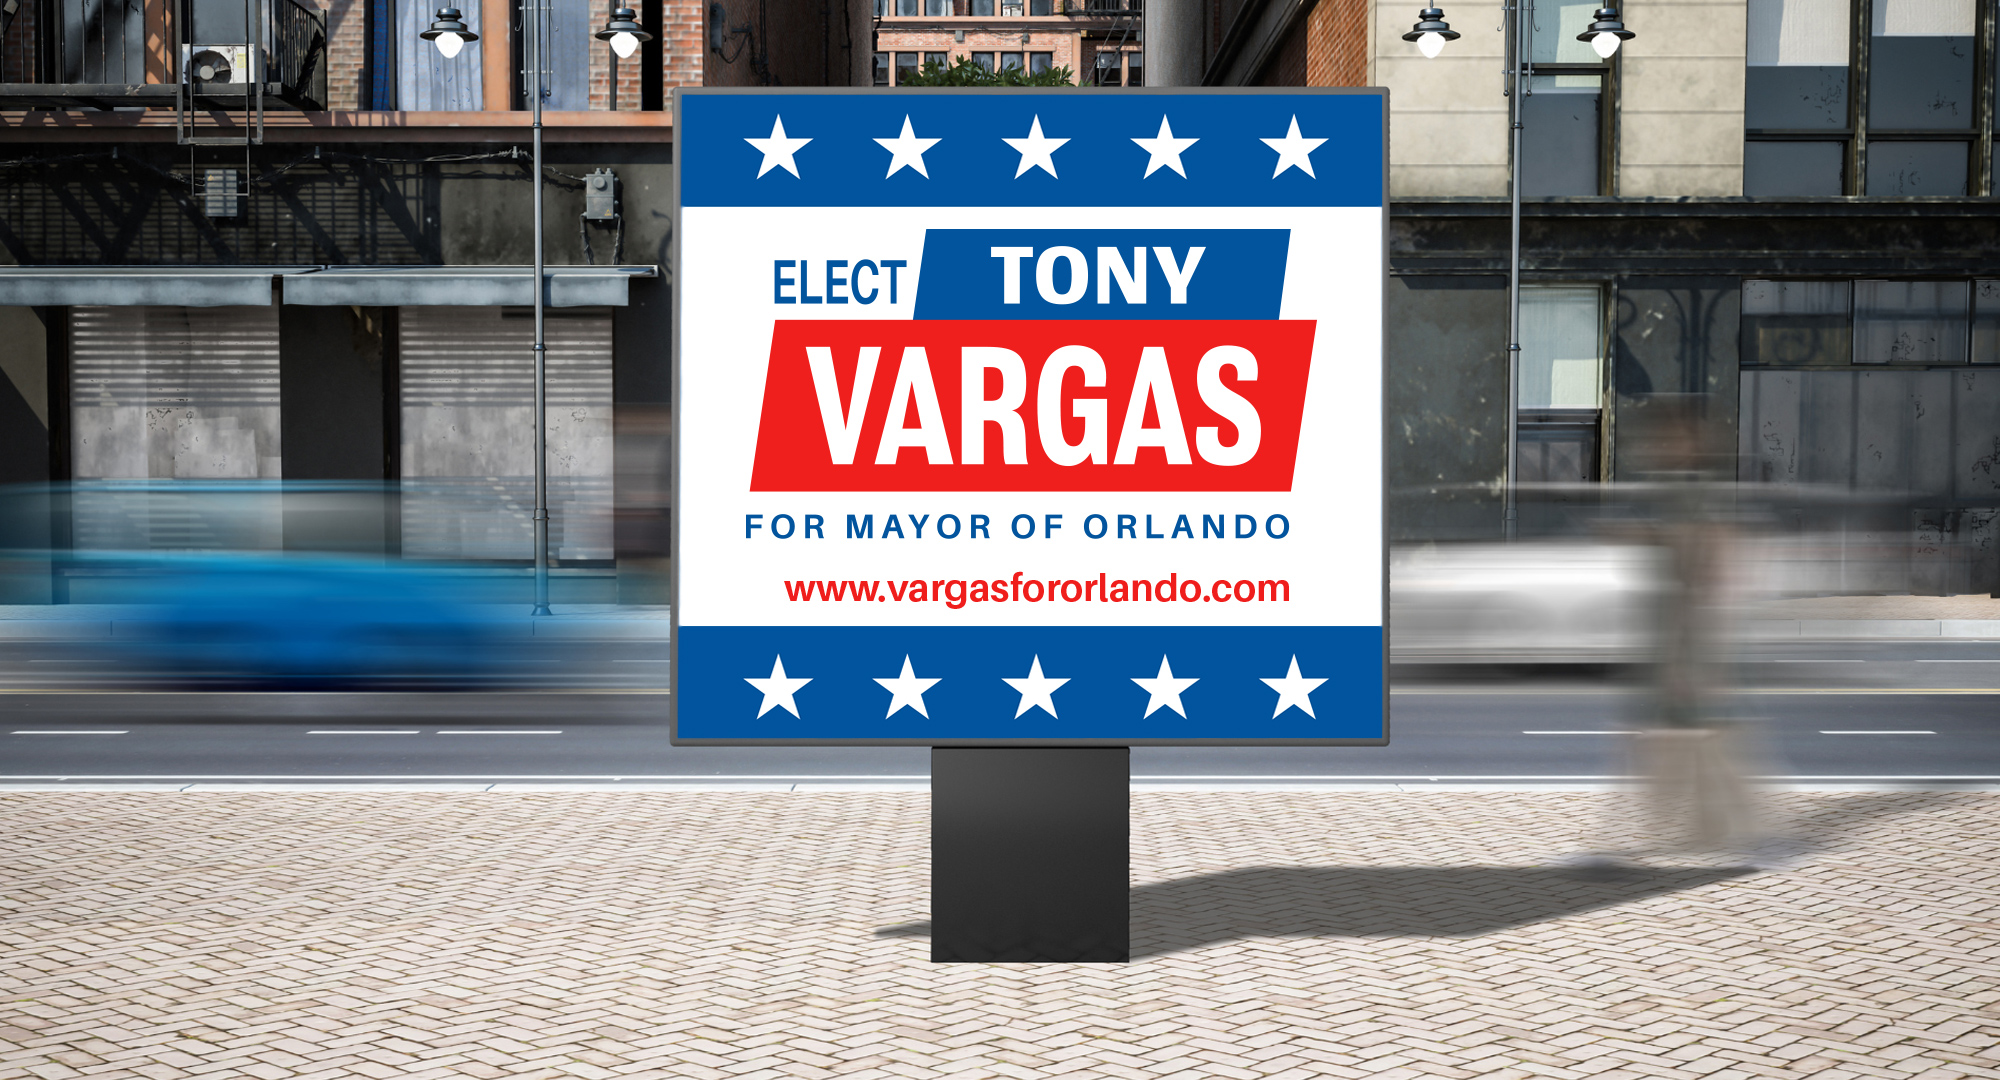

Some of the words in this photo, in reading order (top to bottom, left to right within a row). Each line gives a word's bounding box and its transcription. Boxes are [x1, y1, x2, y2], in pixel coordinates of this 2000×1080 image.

[774, 258, 908, 305] ELECT
[990, 245, 1207, 306] TONY
[805, 344, 1262, 467] VARGAS
[745, 513, 825, 540] FOR
[846, 513, 991, 540] MAYOR
[1011, 513, 1063, 540] OF
[1083, 513, 1290, 540] ORLANDO
[783, 571, 1290, 610] www.vargasfororlando.com
